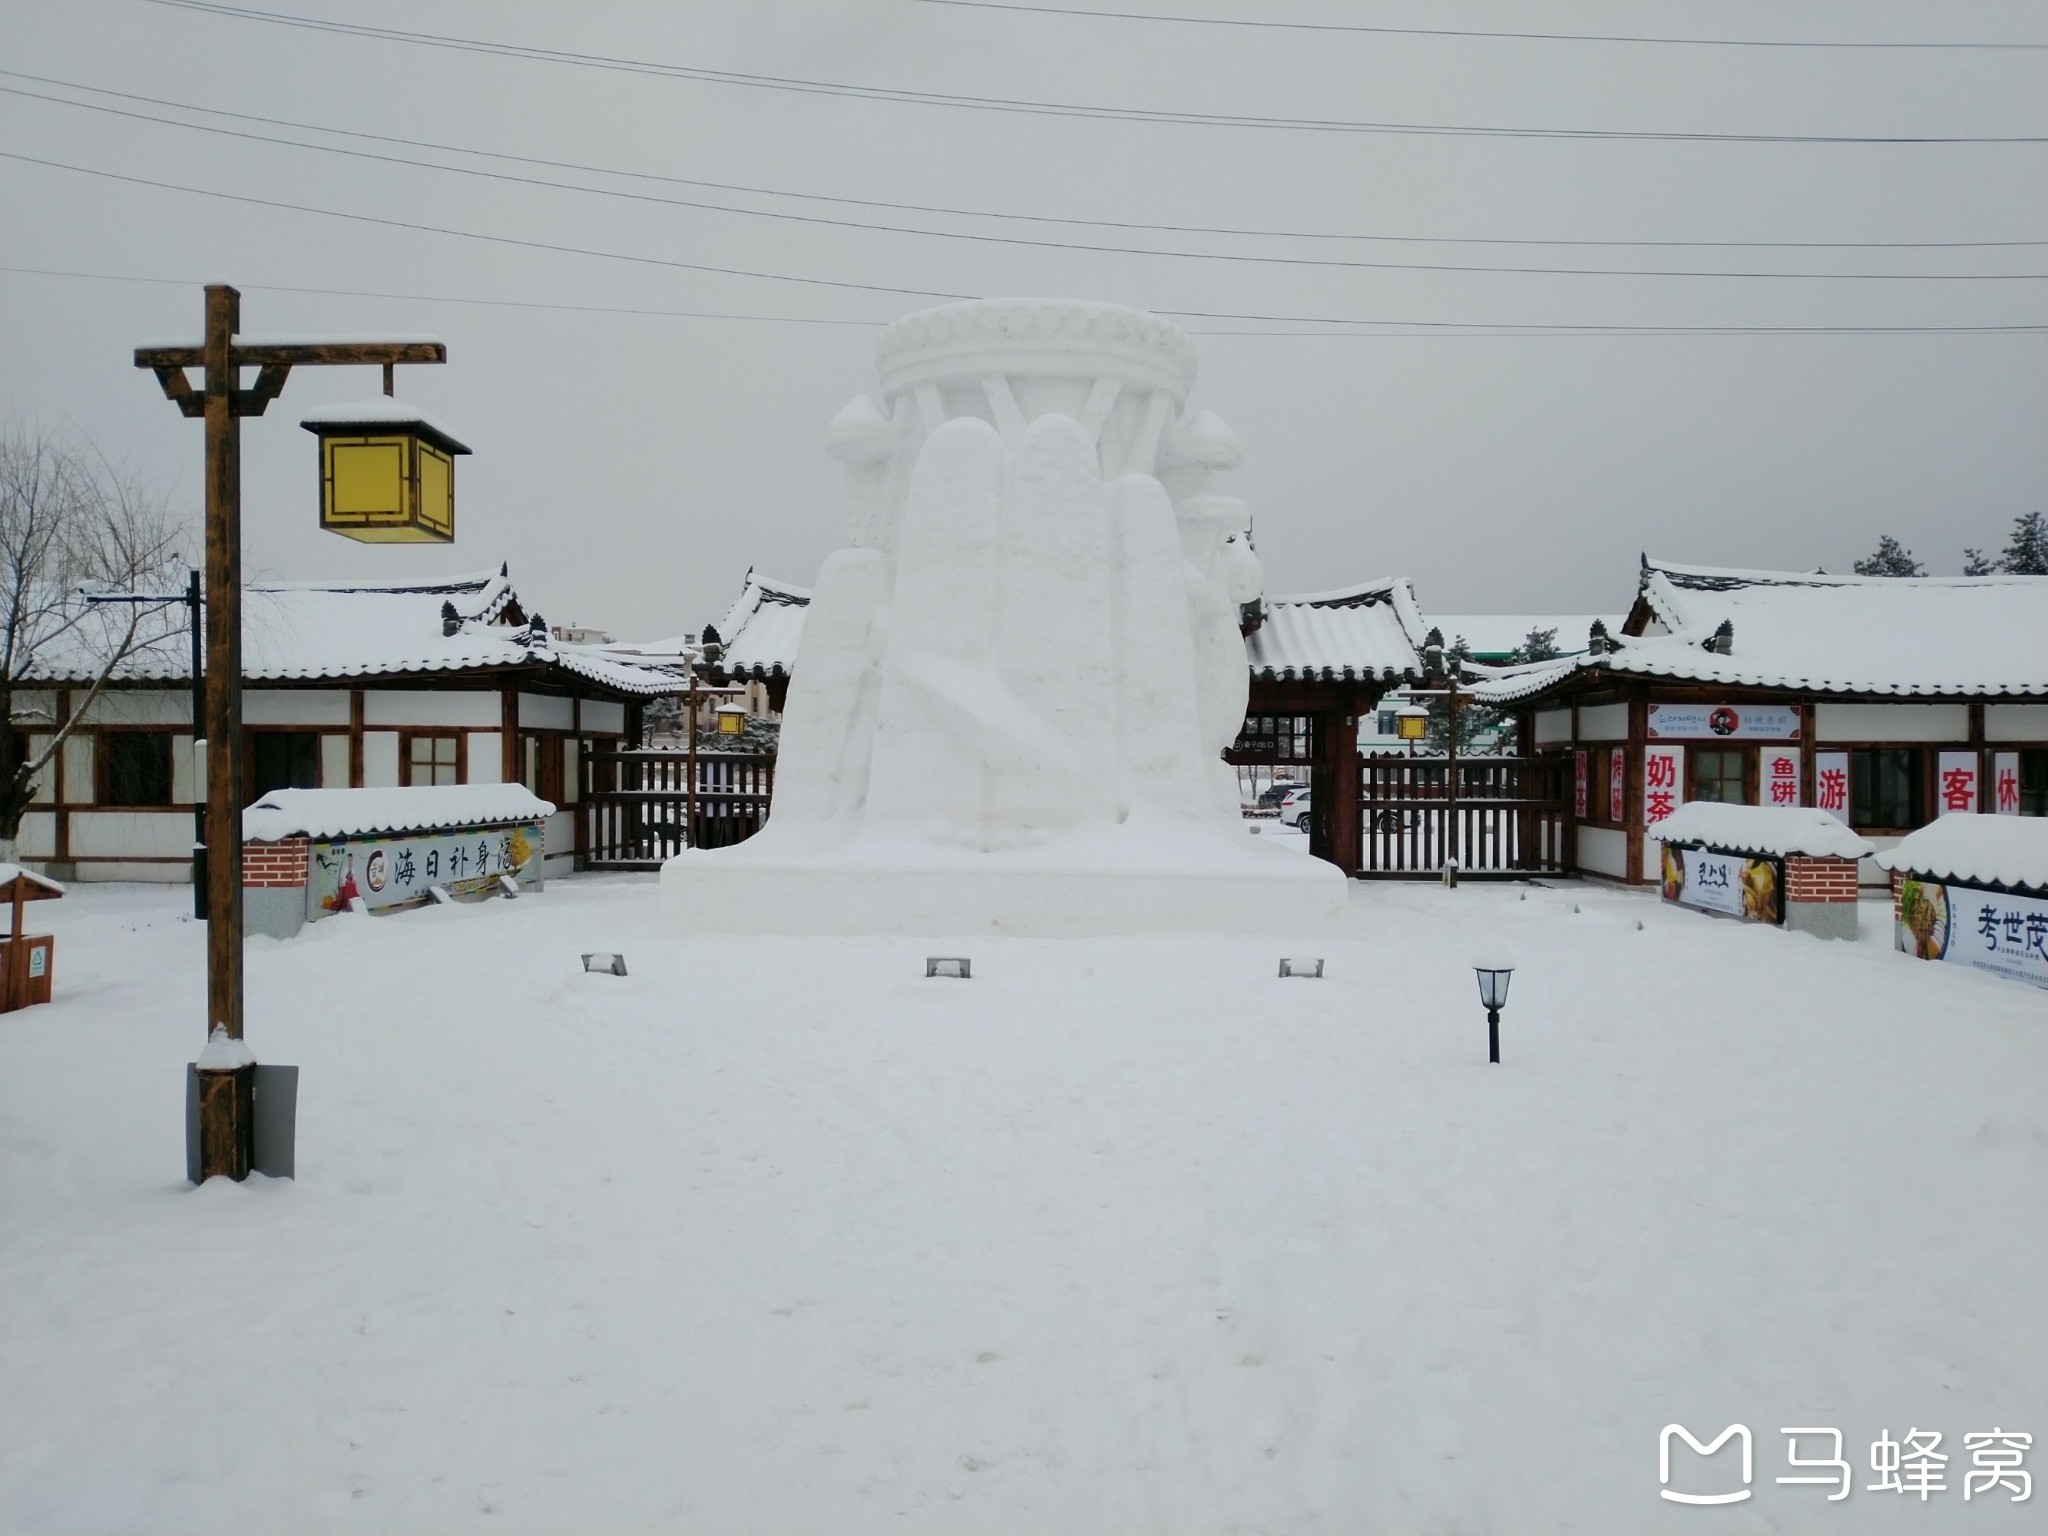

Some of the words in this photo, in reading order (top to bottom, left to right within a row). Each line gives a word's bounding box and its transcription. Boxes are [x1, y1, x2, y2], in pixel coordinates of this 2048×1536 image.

[1576, 751, 1586, 815] 奶茶
[1647, 754, 1676, 823] 奶茶
[1770, 757, 1797, 807] 鱼饼
[1818, 768, 1846, 810] 游
[1942, 767, 1974, 810] 客
[1997, 768, 2018, 811] 休
